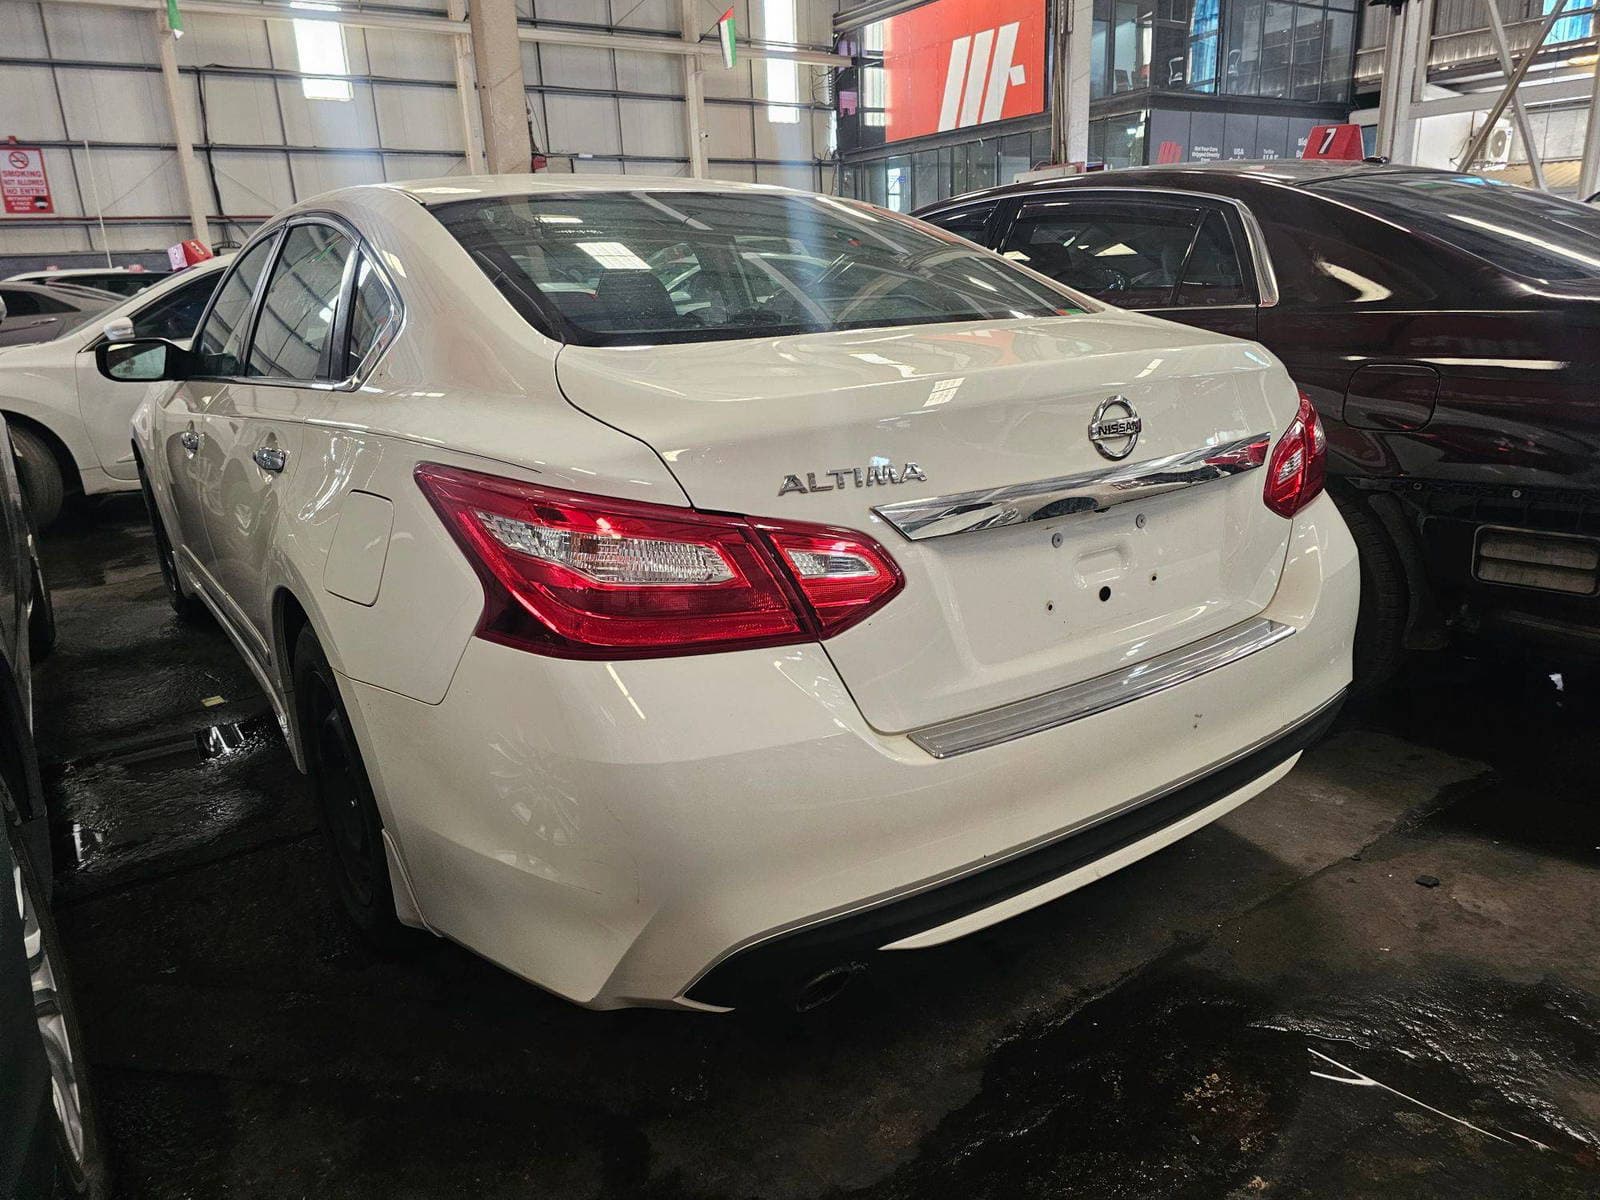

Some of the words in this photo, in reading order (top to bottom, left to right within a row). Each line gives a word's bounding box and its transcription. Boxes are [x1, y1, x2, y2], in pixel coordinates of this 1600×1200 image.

[1319, 127, 1337, 155] 7
[1098, 421, 1139, 436] NISSAN
[777, 461, 928, 497] ALTIMA
